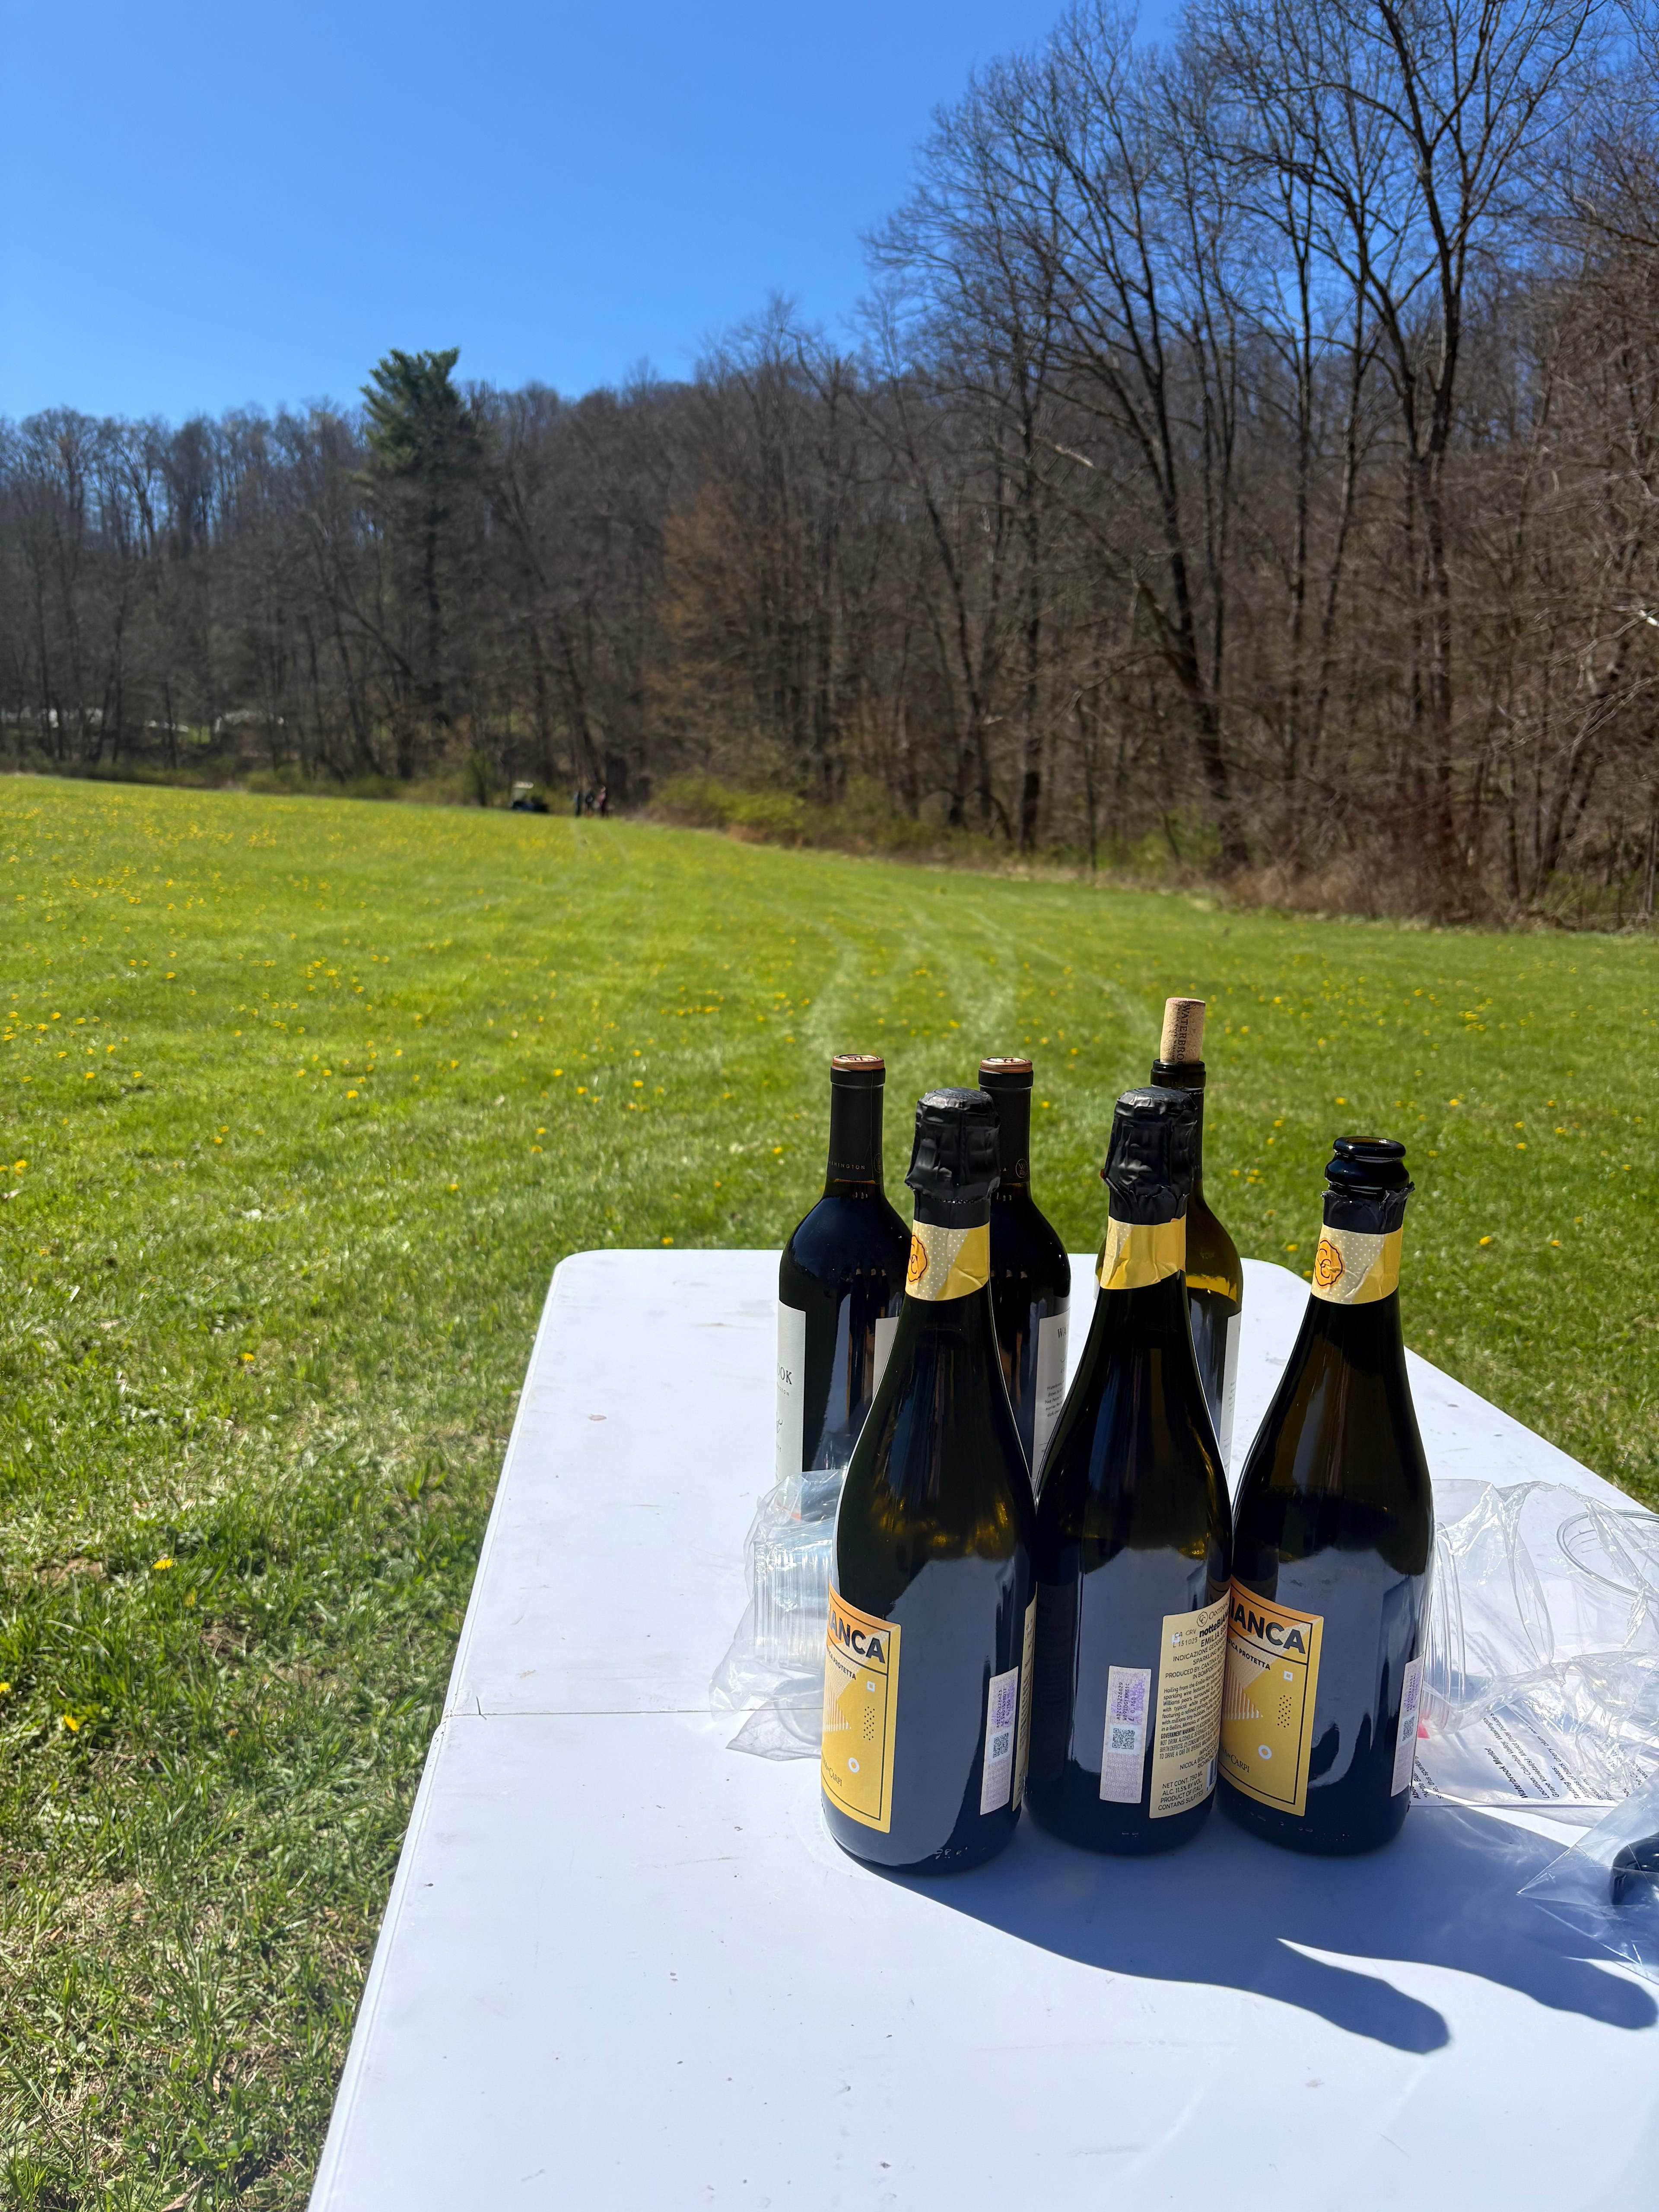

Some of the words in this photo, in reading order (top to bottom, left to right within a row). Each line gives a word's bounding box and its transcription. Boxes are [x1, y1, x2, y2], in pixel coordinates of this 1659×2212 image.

[829, 1161, 865, 1170] SHINGTON
[1199, 1609, 1229, 1637] notteBIAN
[1231, 1595, 1306, 1654] IANCA
[1201, 1632, 1219, 1647] EMILIA
[1173, 1647, 1208, 1662] INDICAZIONE
[1193, 1650, 1217, 1665] SPARKLING
[1239, 1648, 1270, 1670] PROTETTA
[833, 1656, 856, 1680] PROTETTA
[1165, 1668, 1193, 1678] PRODUCED
[1174, 1703, 1187, 1712] typical
[1483, 1718, 1503, 1740] Washingto
[1492, 1716, 1506, 1731] include
[1161, 1730, 1182, 1739] GOVERNMENT
[1503, 1731, 1517, 1742] (may
[1484, 1748, 1503, 1764] Merlot
[1512, 1742, 1527, 1756] Merlot
[1179, 1760, 1197, 1770] NICOLA
[1231, 1754, 1250, 1773] CARPI
[1512, 1754, 1531, 1775] Columbia
[1558, 1763, 1572, 1774] black
[830, 1767, 842, 1786] CARPI
[1426, 1777, 1434, 1785] this
[1550, 1766, 1566, 1781] Notes:
[1499, 1766, 1528, 1798] Waterbrook
[1529, 1776, 1550, 1799] Location:
[1160, 1792, 1185, 1803] PRODUCT
[1192, 1783, 1203, 1794] ITALY
[1545, 1783, 1560, 1797] Grape
[1564, 1782, 1581, 1799] Tasting
[1574, 1781, 1592, 1799] Aromas
[1158, 1799, 1185, 1810] CONTAINS
[1185, 1789, 1204, 1803] SULFITES
